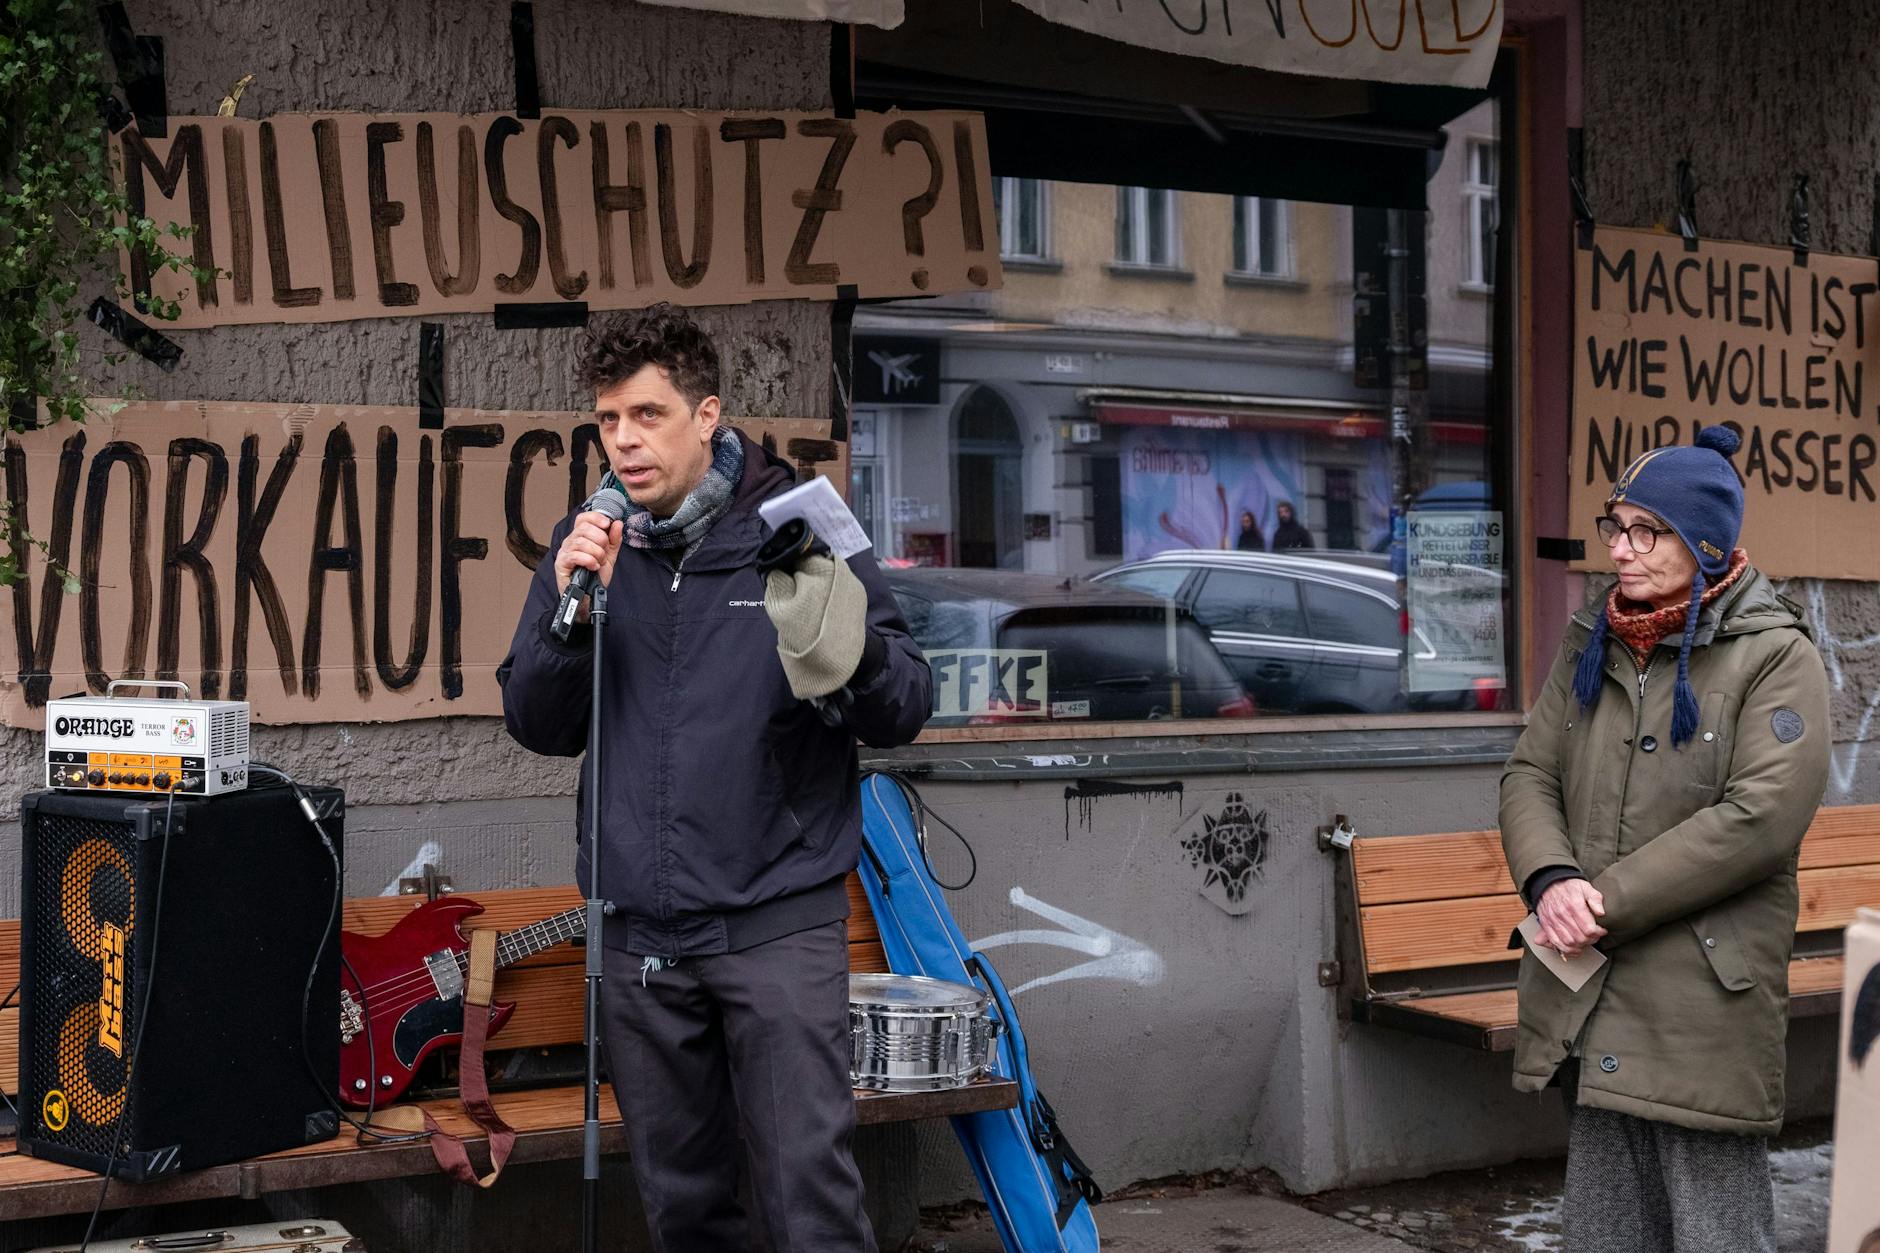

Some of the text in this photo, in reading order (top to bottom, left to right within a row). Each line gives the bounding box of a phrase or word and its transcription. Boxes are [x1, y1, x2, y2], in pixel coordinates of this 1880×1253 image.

[1590, 244, 1878, 349] MACHEN IST
[1586, 334, 1668, 399] WIE
[1692, 420, 1877, 502] ASSER
[1409, 522, 1500, 538] KUNDGEBUNG
[55, 716, 135, 740] ORANGE
[140, 722, 166, 731] TERROR
